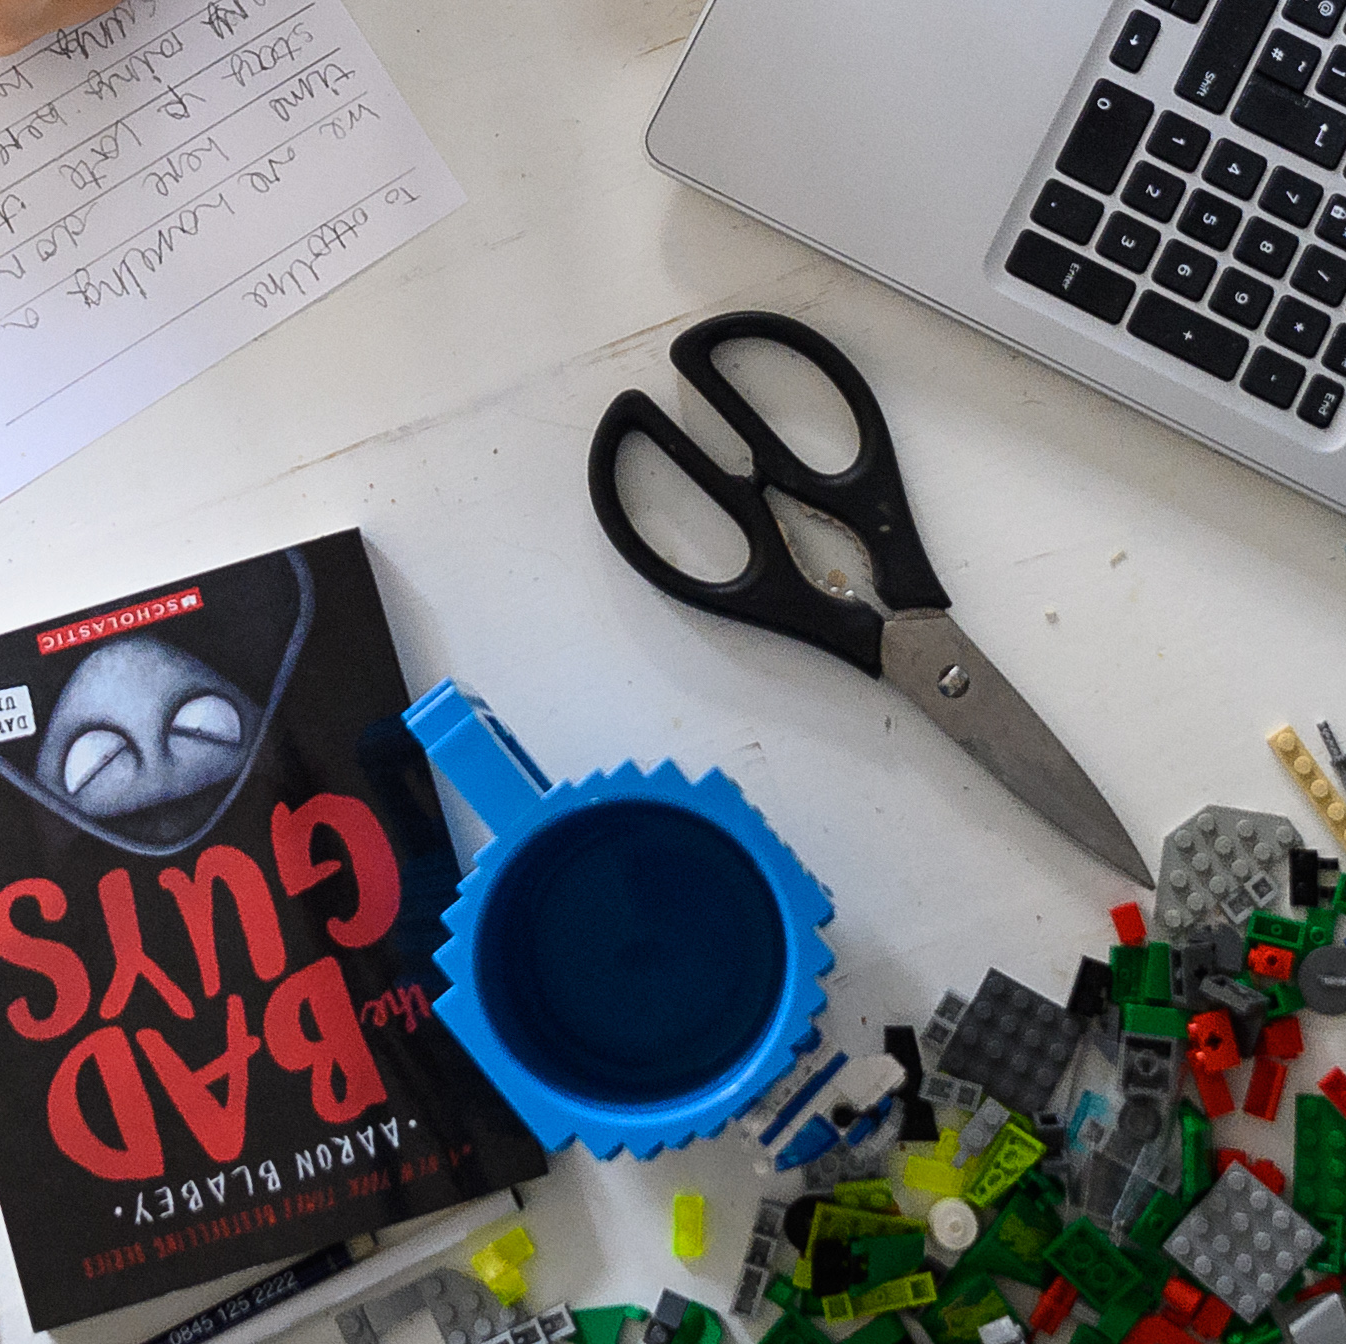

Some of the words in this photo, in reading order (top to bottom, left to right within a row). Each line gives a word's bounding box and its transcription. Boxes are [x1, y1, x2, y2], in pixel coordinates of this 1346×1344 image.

[83, 31, 184, 100] rainy
[229, 24, 314, 87] stay
[269, 62, 355, 122] time
[1195, 70, 1215, 97] Shift
[1096, 97, 1111, 110] 0
[1171, 137, 1185, 145] 1
[1226, 162, 1240, 175] 4
[1144, 184, 1160, 198] 2
[1285, 190, 1299, 204] 7
[1201, 212, 1217, 225] 5
[35, 201, 97, 262] do
[1120, 234, 1135, 248] 3
[1258, 240, 1273, 254] 8
[1061, 262, 1080, 290] Enter
[1176, 263, 1191, 276] 6
[1234, 291, 1248, 304] 9
[0, 307, 40, 329] a
[1317, 392, 1335, 416] End
[41, 598, 179, 651] SCHOLASTIC
[358, 984, 430, 1043] the
[45, 955, 387, 1180] BAD
[294, 1116, 399, 1180] AARON
[134, 1159, 281, 1224] BLABEY
[217, 1295, 250, 1321] 125
[251, 1271, 298, 1305] 2222
